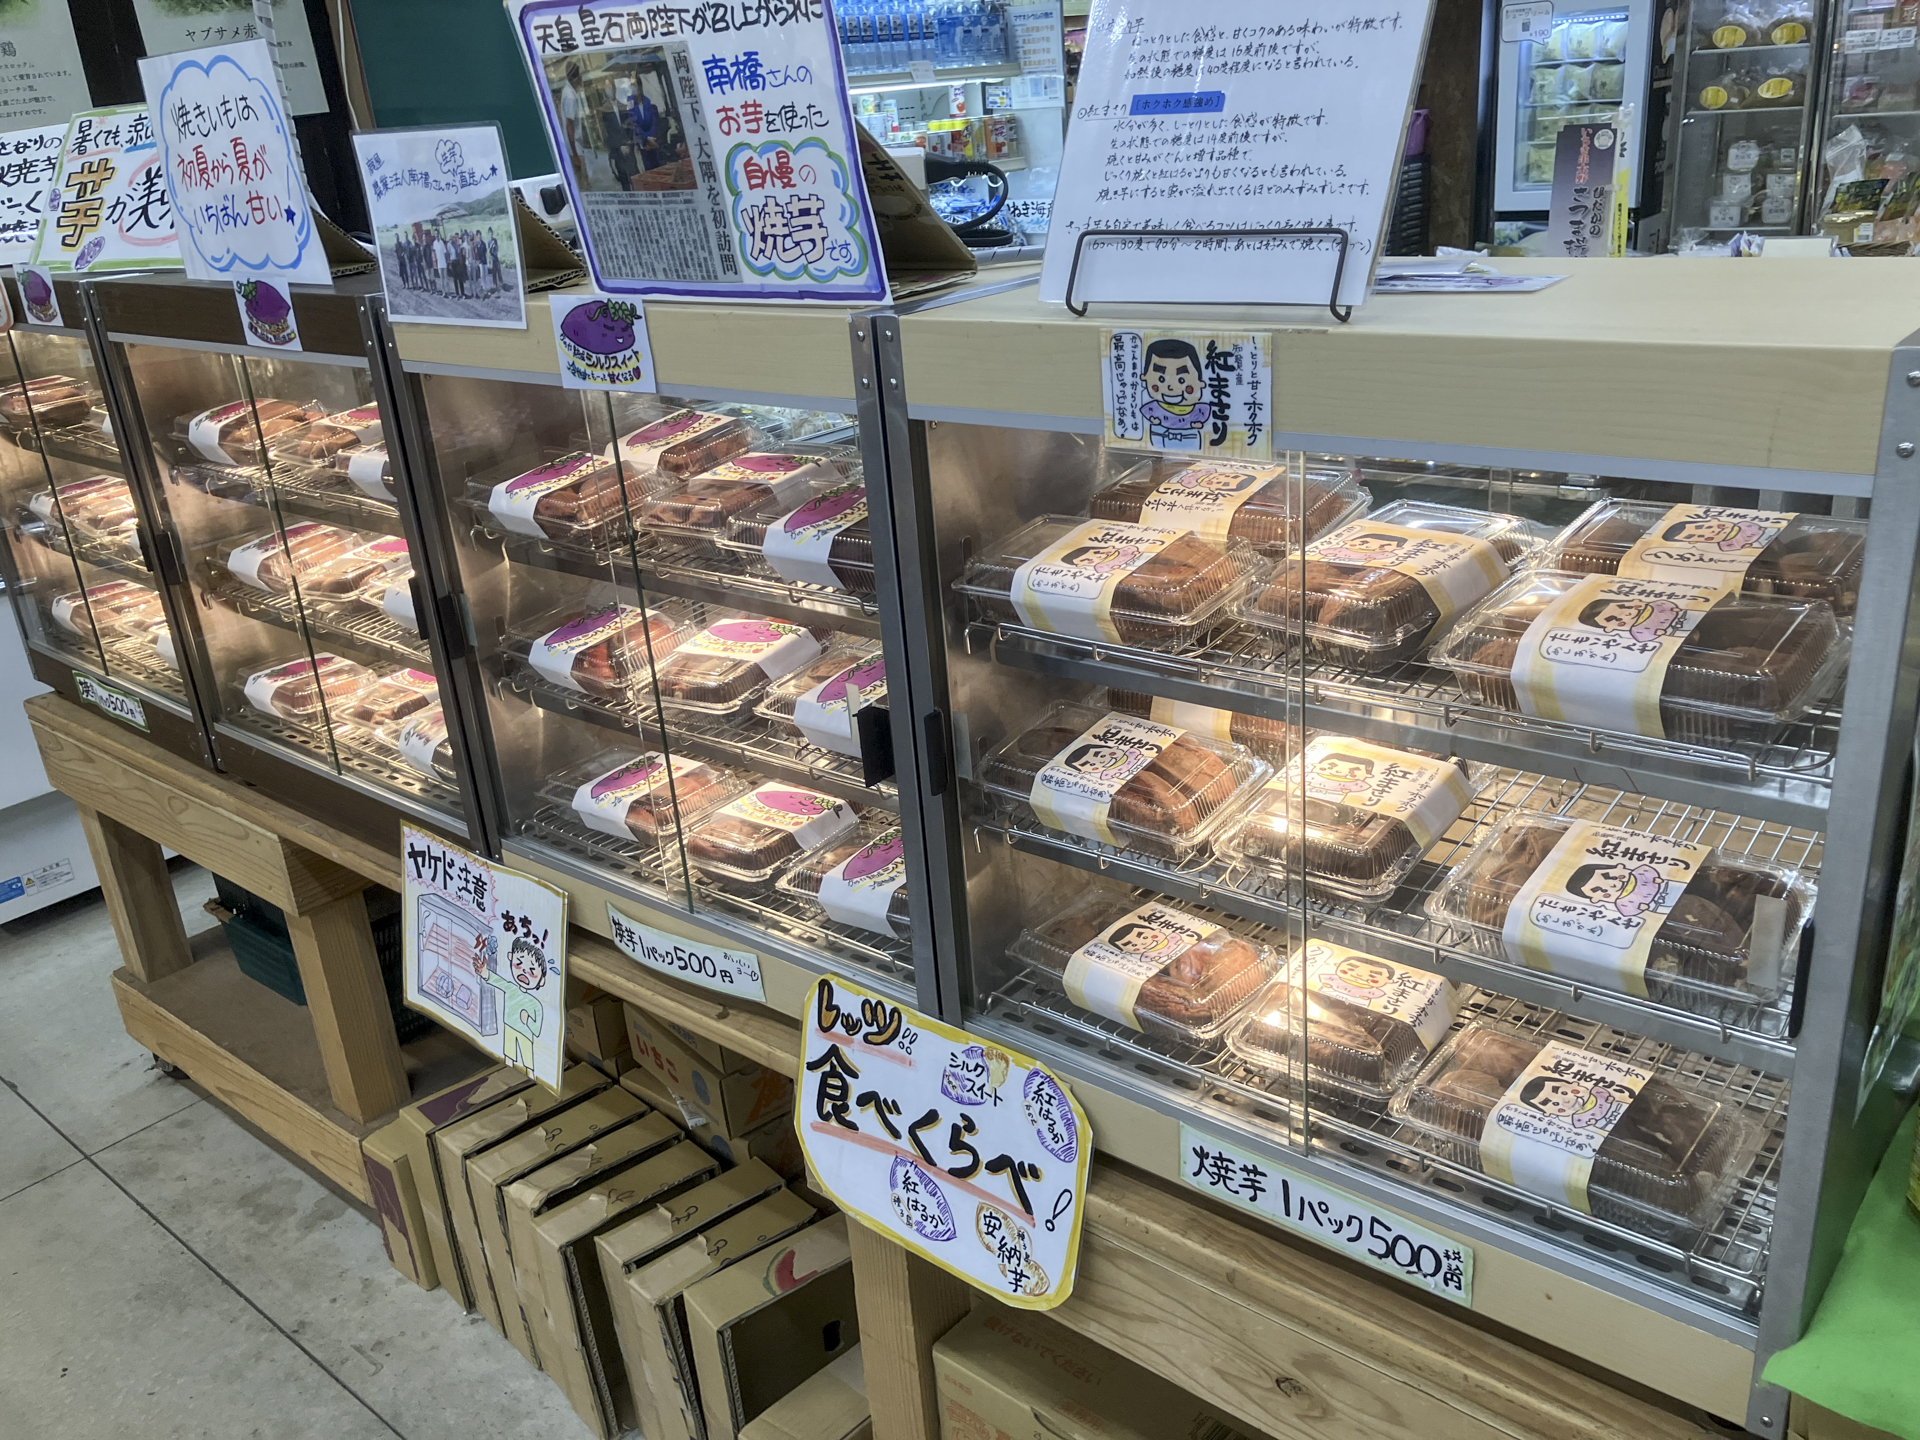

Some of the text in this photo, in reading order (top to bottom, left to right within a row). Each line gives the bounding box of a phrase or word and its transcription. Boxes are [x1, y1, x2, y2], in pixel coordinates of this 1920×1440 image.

[702, 51, 813, 95] 南橋さんの
[171, 95, 259, 143] 焼きいもは
[716, 99, 830, 136] お芋を使った
[177, 136, 273, 193] 初夏から夏が
[671, 50, 739, 277] 両陛下、大隅を初訪問
[743, 150, 817, 191] 自慢の
[193, 190, 284, 235] いちばん甘い
[1204, 339, 1236, 447] 紅まさり
[1600, 583, 1711, 603] 紅まさり
[1092, 728, 1163, 755] 紅まさり
[1361, 762, 1414, 807] 紅まさり
[407, 842, 488, 913] ヤケド注意
[1586, 839, 1691, 871] 紅まさり
[1137, 911, 1203, 942] 紅まさり
[611, 915, 734, 985] 焼芋1パック500円
[948, 1051, 986, 1078] シルク
[1541, 1059, 1637, 1100] 紅まさり
[965, 1077, 1004, 1108] スイート
[1031, 1080, 1065, 1145] 紅はるか
[901, 1169, 945, 1229] 紅はるか
[983, 1211, 1031, 1293] 安納芋
